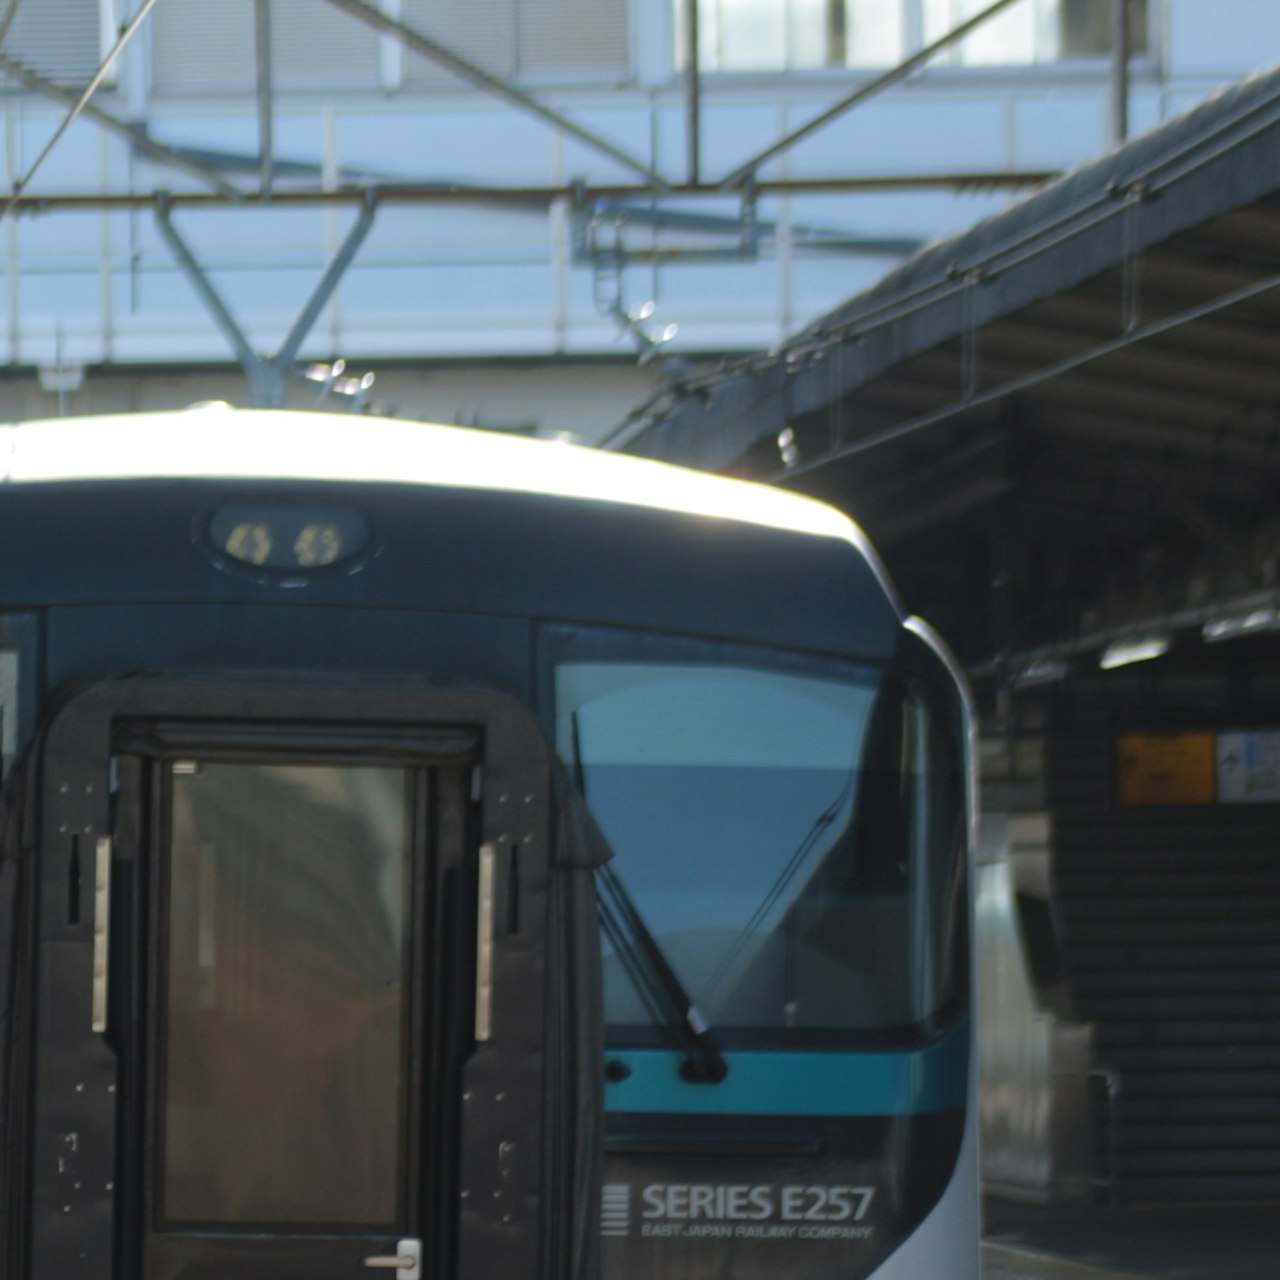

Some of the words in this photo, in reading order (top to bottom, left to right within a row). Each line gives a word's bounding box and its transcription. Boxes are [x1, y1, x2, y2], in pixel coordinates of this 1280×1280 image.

[642, 1184, 775, 1220] SERIES
[781, 1184, 876, 1222] E257
[641, 1225, 682, 1238] EAST
[683, 1226, 732, 1238] JAPAN
[735, 1226, 797, 1239] RAILWAY
[798, 1227, 873, 1240] COMPANY
